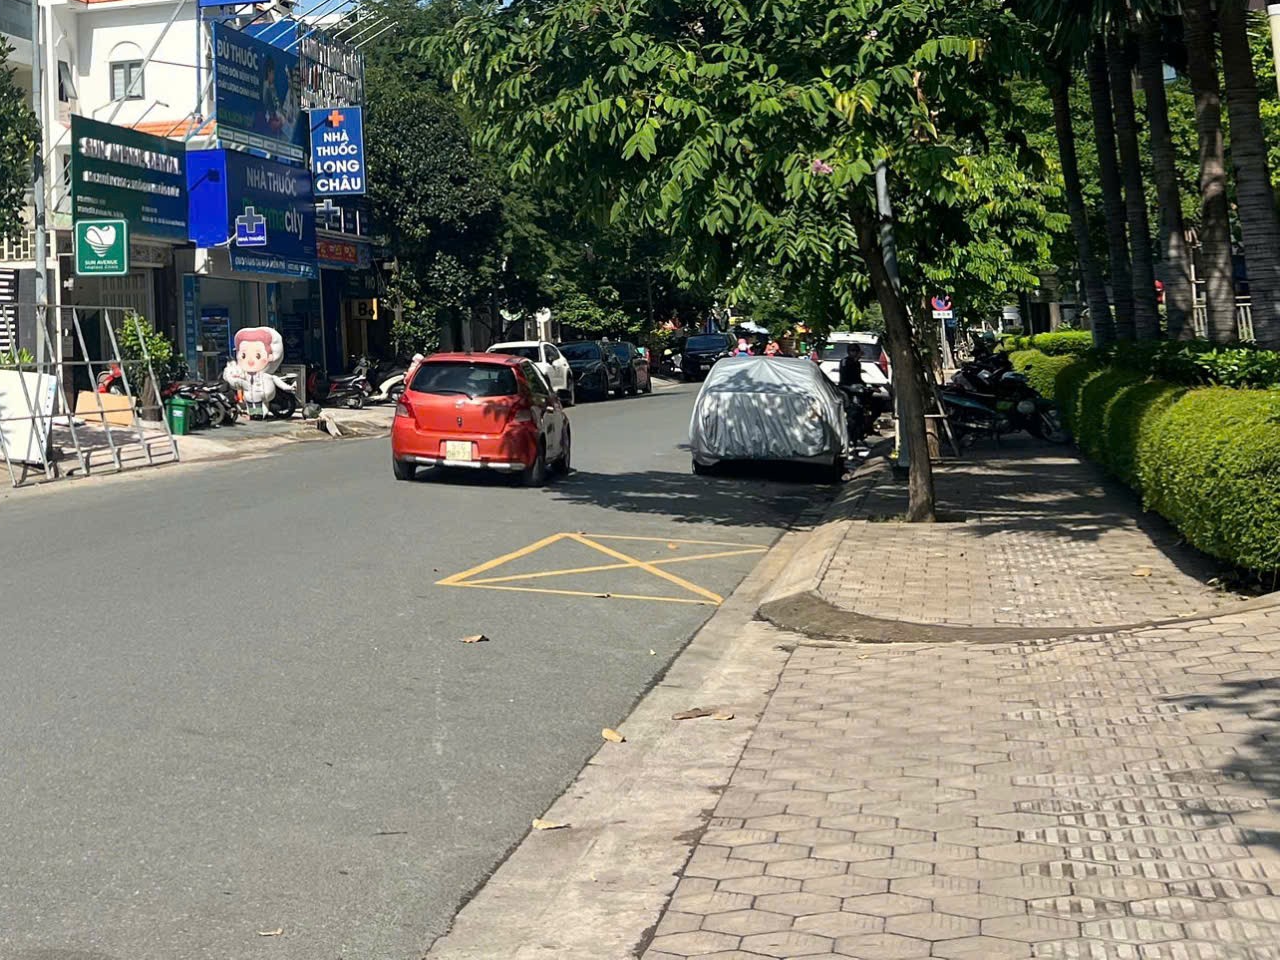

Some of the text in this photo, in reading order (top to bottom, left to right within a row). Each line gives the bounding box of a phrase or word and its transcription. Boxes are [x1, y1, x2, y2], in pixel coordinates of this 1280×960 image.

[230, 44, 258, 71] THUỐC
[323, 128, 350, 143] NHÀ
[316, 141, 358, 157] THUỐC
[316, 159, 360, 174] LONG
[246, 165, 297, 197] NHÀ THUỐC
[316, 175, 362, 191] CHÂU
